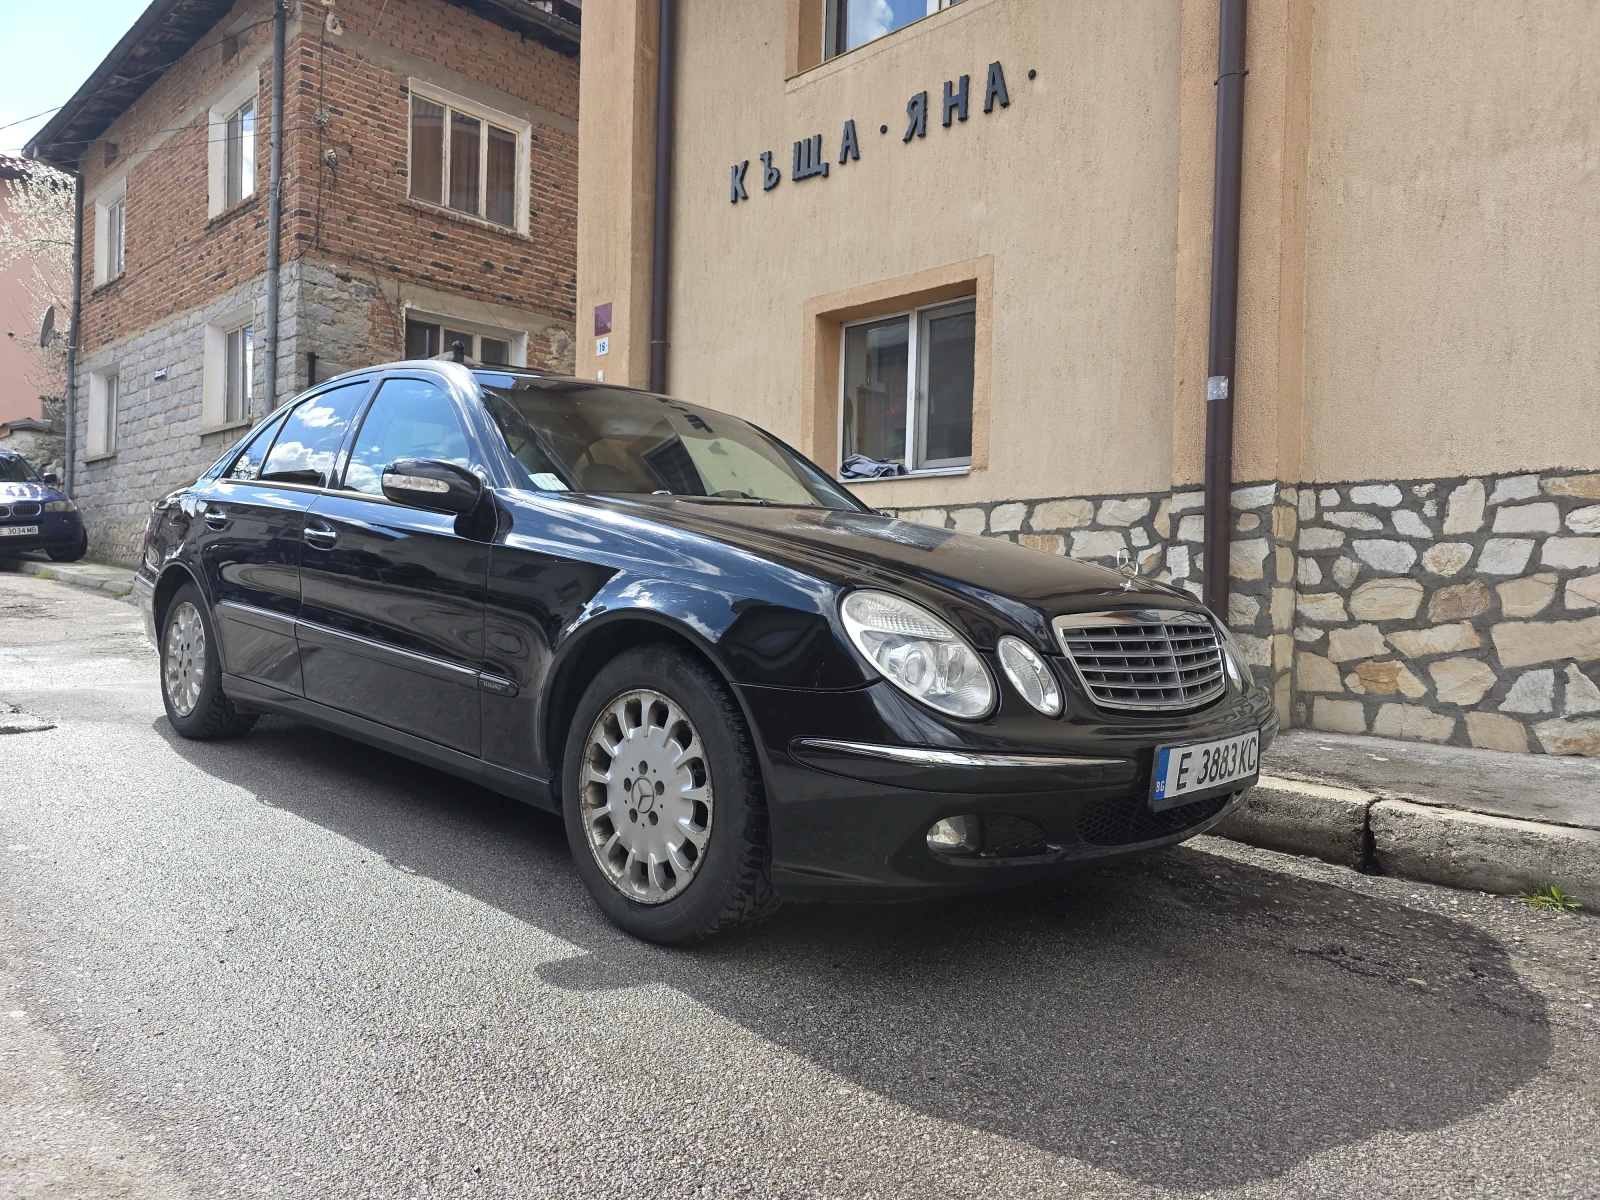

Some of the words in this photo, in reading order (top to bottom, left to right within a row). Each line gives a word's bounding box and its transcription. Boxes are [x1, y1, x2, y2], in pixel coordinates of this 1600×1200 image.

[730, 118, 861, 204] КЪЩА
[902, 60, 1010, 144] ЯНА
[1155, 780, 1165, 793] BG
[1176, 751, 1193, 791] E
